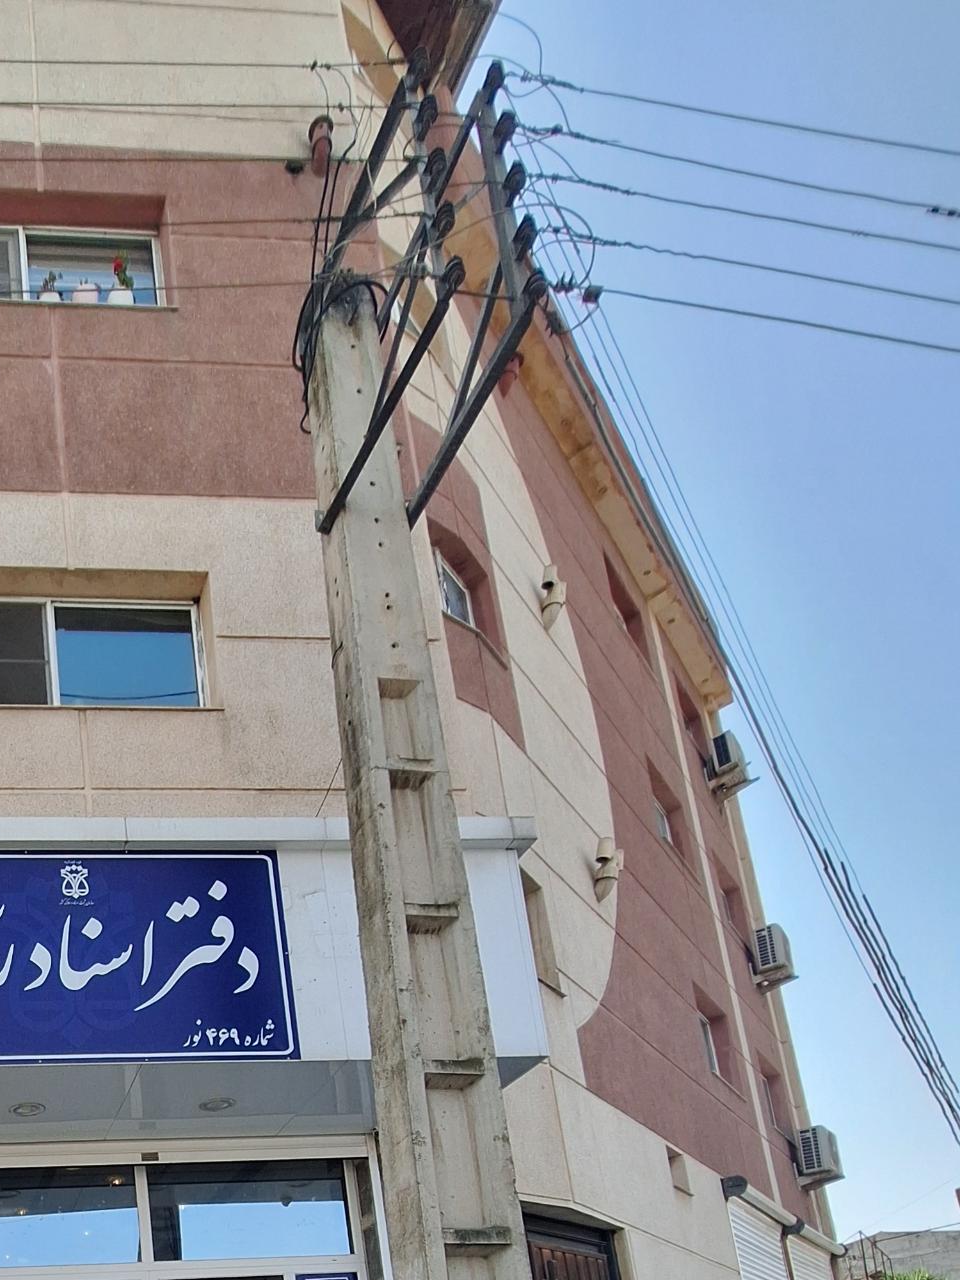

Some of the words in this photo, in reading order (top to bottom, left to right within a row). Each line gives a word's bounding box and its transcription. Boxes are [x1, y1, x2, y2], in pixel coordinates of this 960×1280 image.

[24, 914, 155, 992] اسناد
[134, 880, 259, 1012] دفتر
[183, 1019, 202, 1047] نور
[206, 1028, 240, 1047] ۴۶۹
[244, 1019, 275, 1047] شماره
